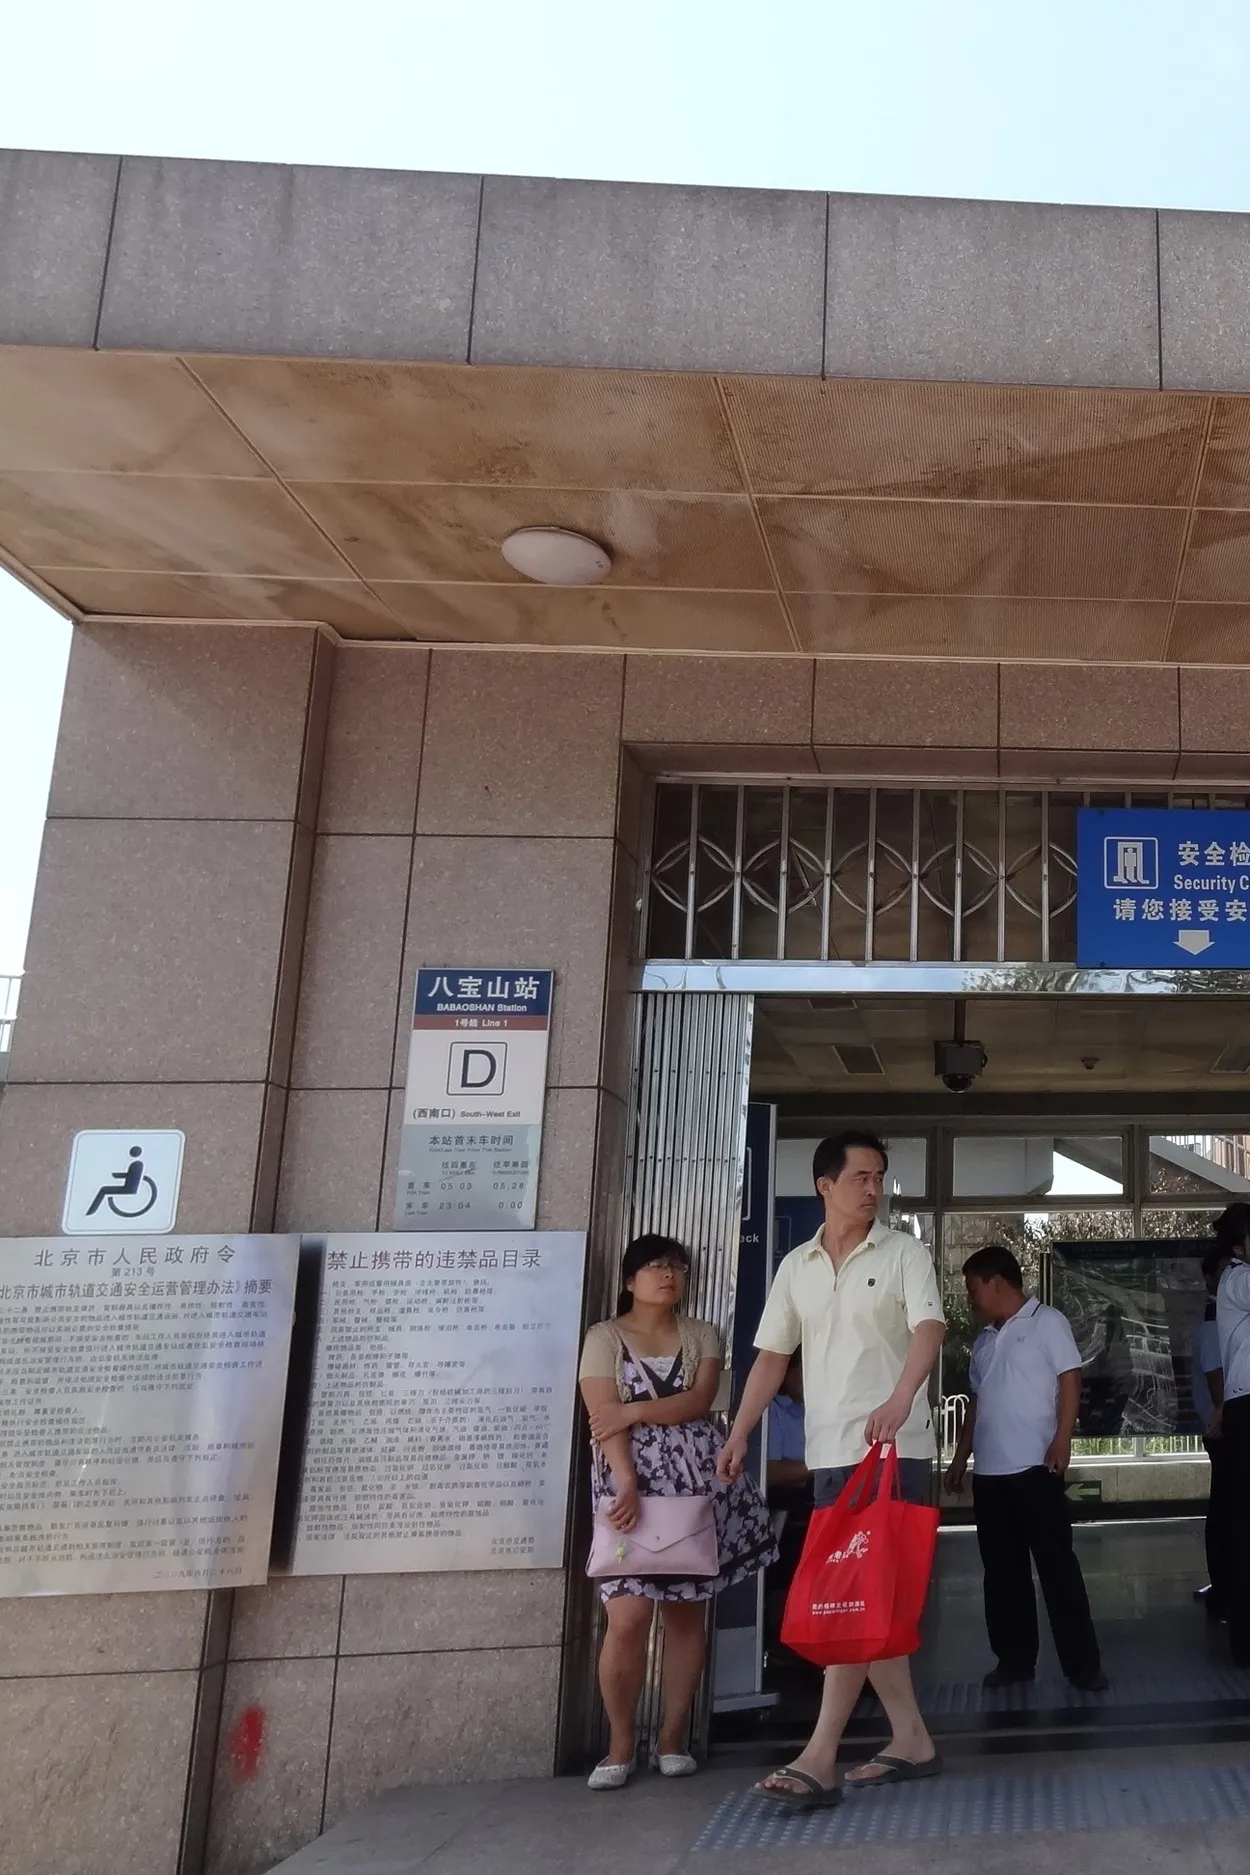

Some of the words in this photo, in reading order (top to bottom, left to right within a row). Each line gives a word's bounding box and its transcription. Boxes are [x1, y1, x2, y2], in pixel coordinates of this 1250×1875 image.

[1173, 874, 1235, 893] Security
[427, 975, 540, 999] 八宝山站
[436, 1003, 495, 1012] BABAOSHAN
[496, 1003, 528, 1012] Station
[454, 1019, 478, 1028] 1号线
[481, 1019, 501, 1028] Line
[460, 1049, 497, 1088] D
[459, 1110, 505, 1118] South-West
[506, 1110, 521, 1118] Exit
[429, 1135, 514, 1146] 本站首末车时间
[33, 1244, 236, 1267] 北京市人民政府令
[327, 1249, 543, 1270] 禁止携带的违禁品目录
